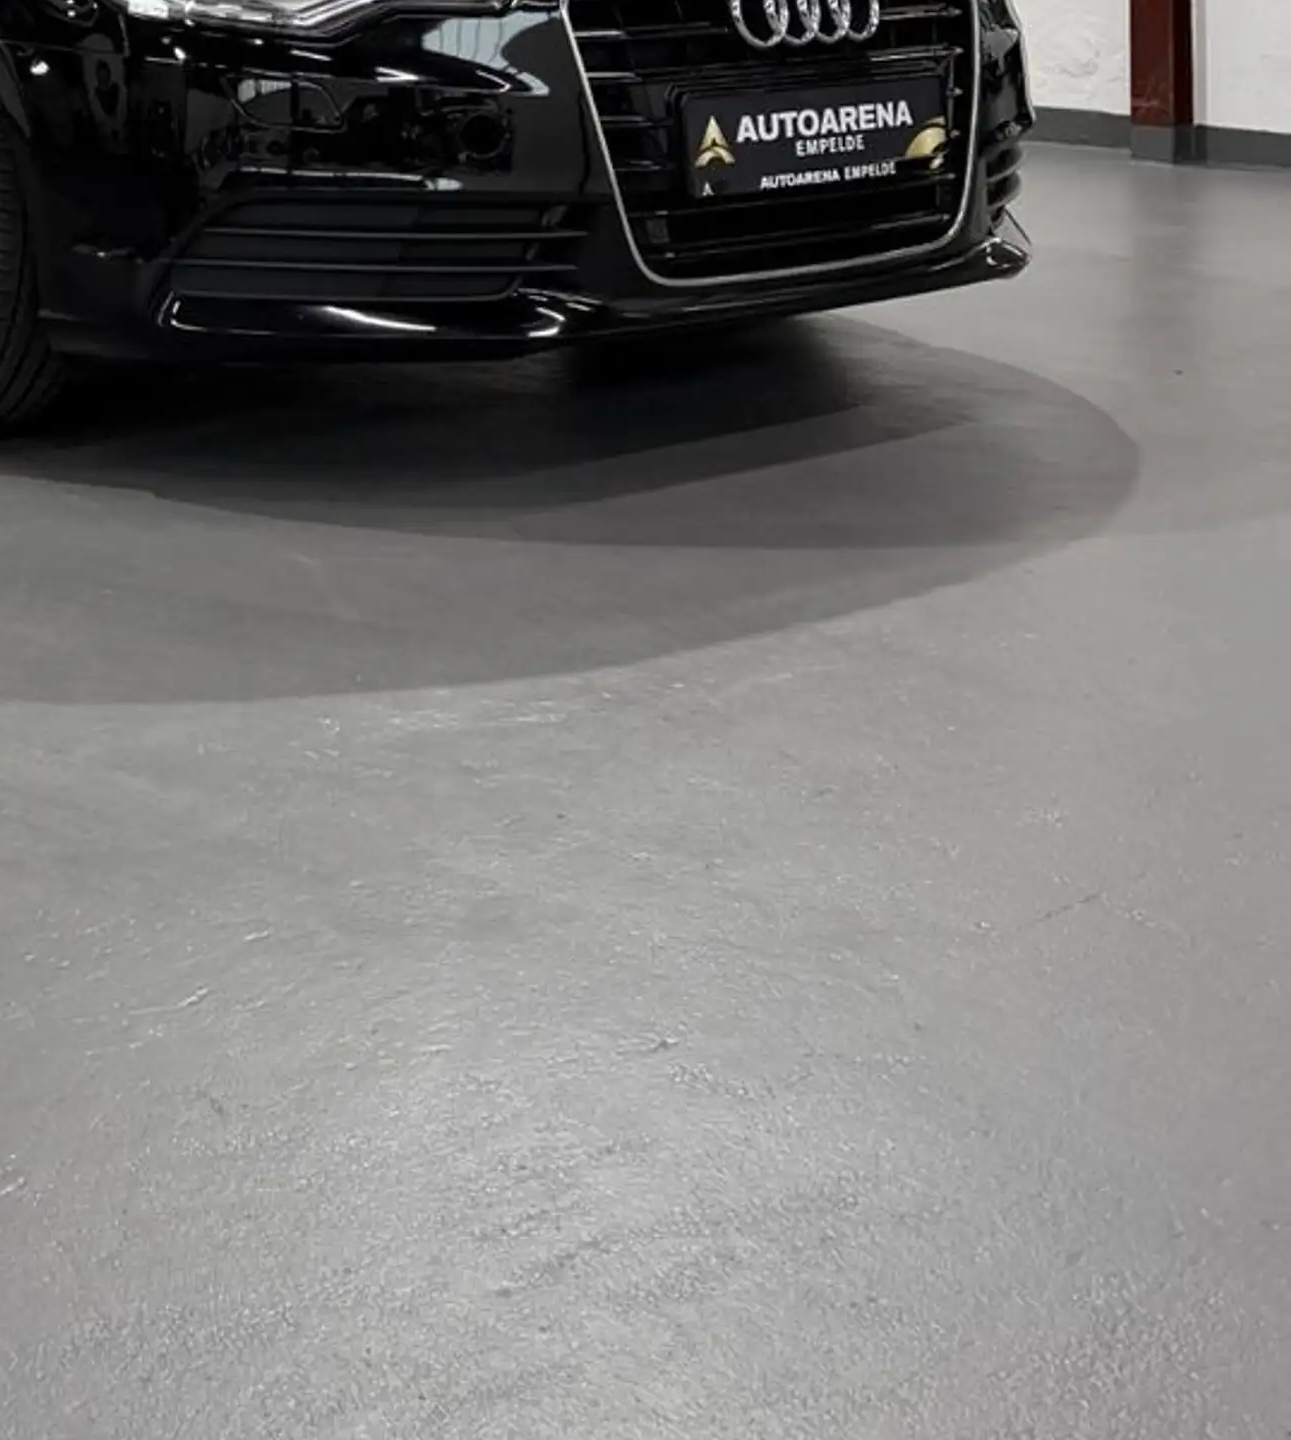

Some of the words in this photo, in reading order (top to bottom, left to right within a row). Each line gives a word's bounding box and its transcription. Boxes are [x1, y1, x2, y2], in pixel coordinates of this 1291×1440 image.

[736, 101, 913, 143] AUTOARENA
[796, 135, 865, 157] EMPELDE
[760, 169, 841, 190] AUTOARENA
[844, 160, 896, 180] EMPELDE
